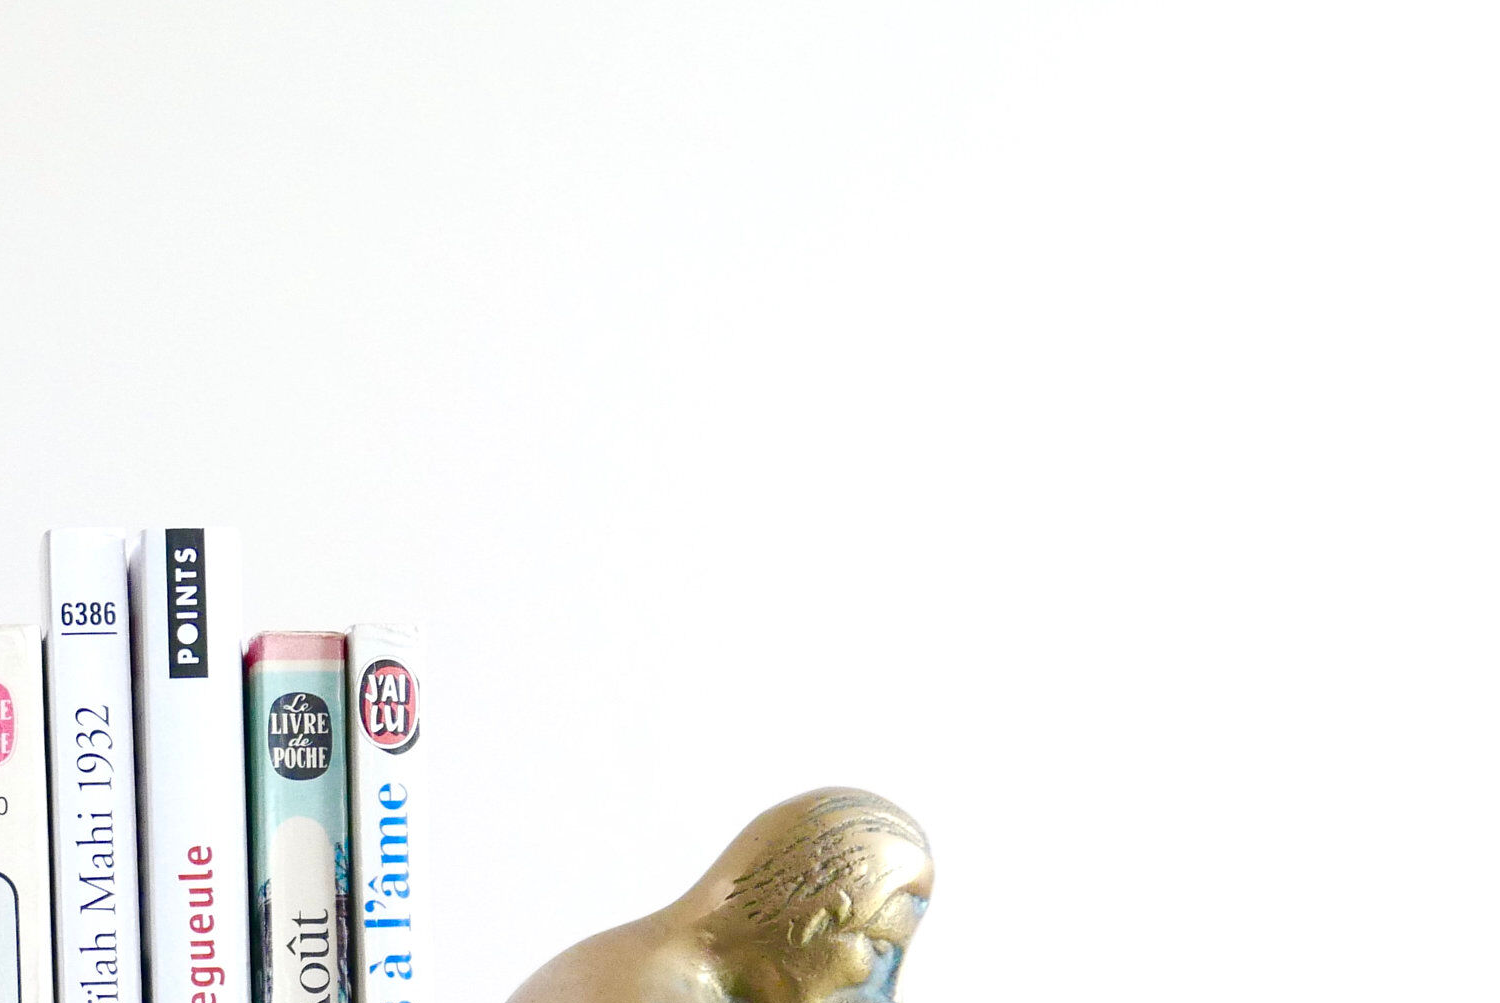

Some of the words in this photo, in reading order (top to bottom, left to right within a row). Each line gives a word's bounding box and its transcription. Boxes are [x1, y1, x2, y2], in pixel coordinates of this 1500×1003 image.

[60, 602, 116, 626] 6386
[175, 547, 199, 665] POINTS
[365, 674, 406, 702] J'AI
[283, 694, 311, 713] Le
[271, 712, 329, 735] LIVRE
[370, 704, 405, 732] LU
[75, 704, 114, 791] 1932
[288, 733, 312, 747] de
[274, 747, 328, 769] POCHE
[76, 809, 116, 914] Mahi
[369, 951, 412, 981] à
